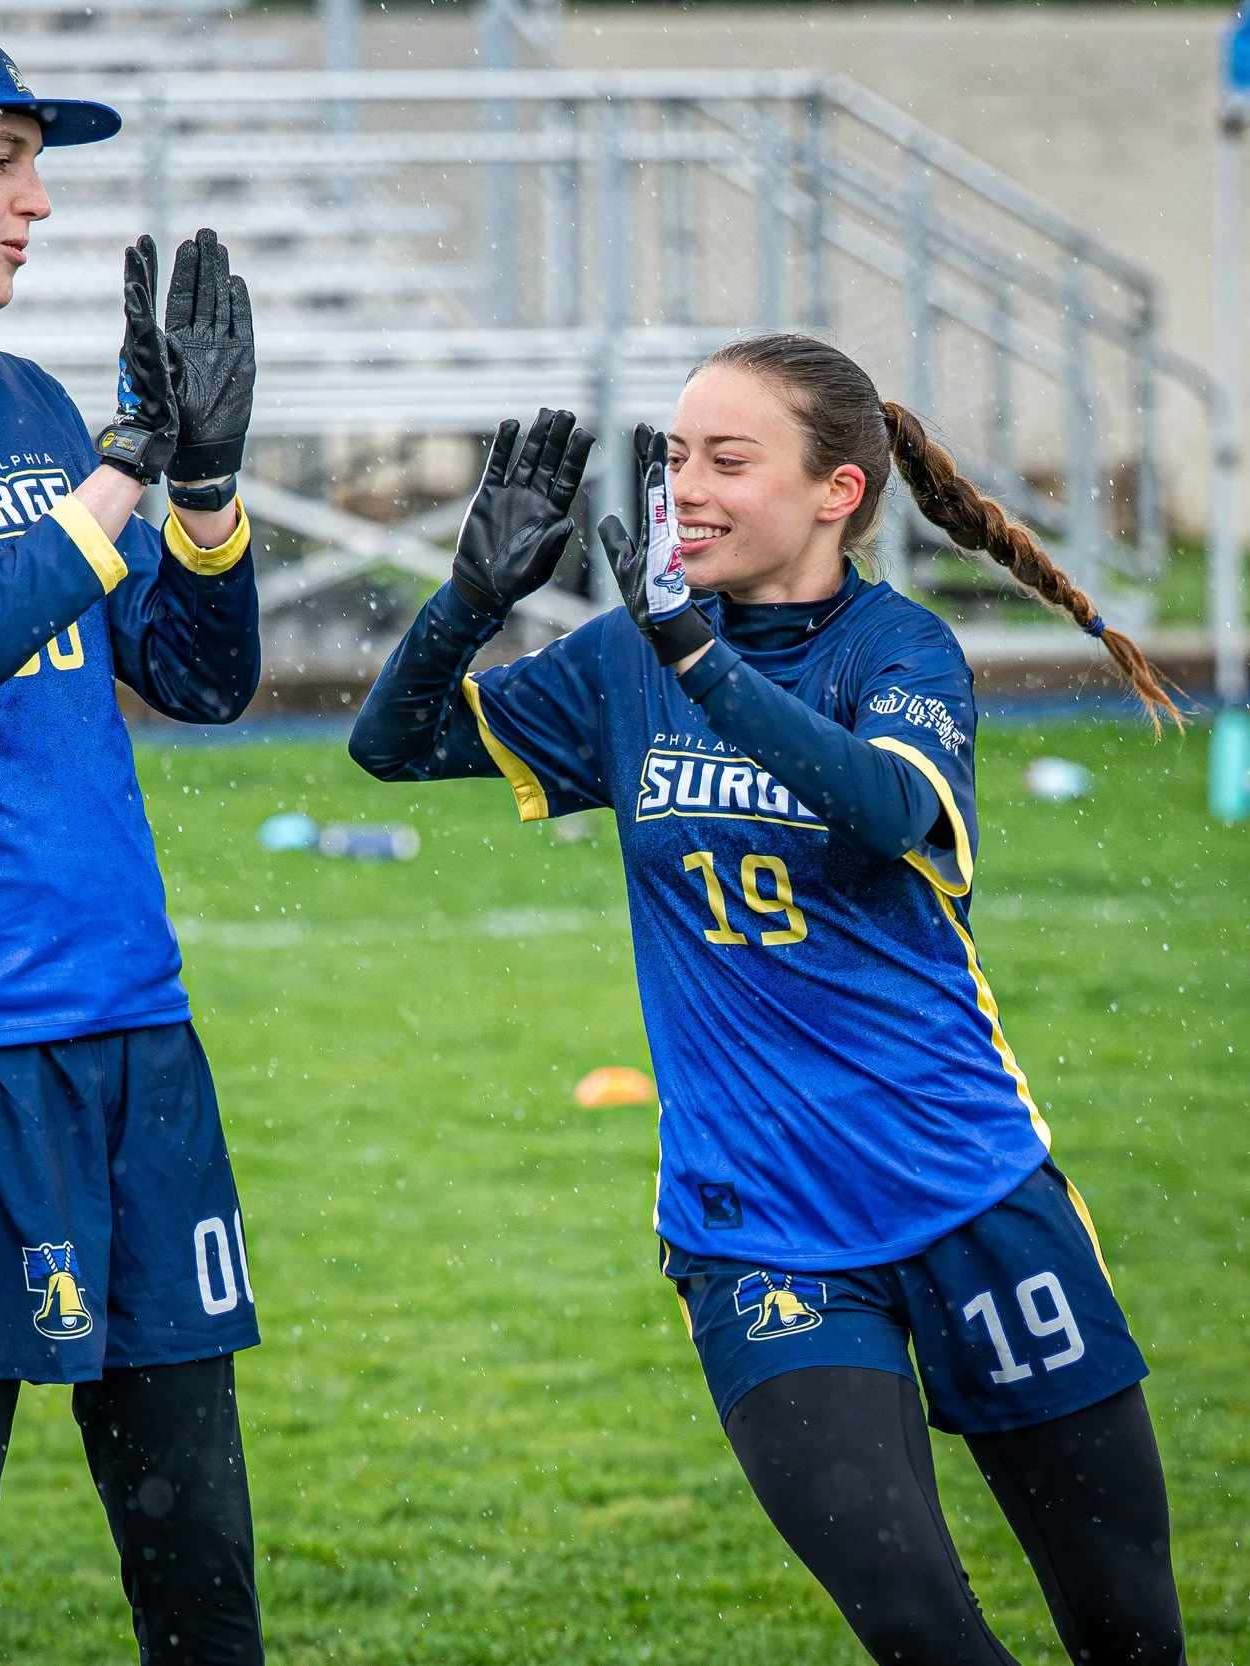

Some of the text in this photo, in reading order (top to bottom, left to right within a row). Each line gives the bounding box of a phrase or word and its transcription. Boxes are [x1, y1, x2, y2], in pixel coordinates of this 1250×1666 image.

[653, 733, 738, 752] PHILAD
[641, 756, 820, 818] SURG
[683, 850, 808, 946] 19
[962, 1271, 1086, 1385] 19
